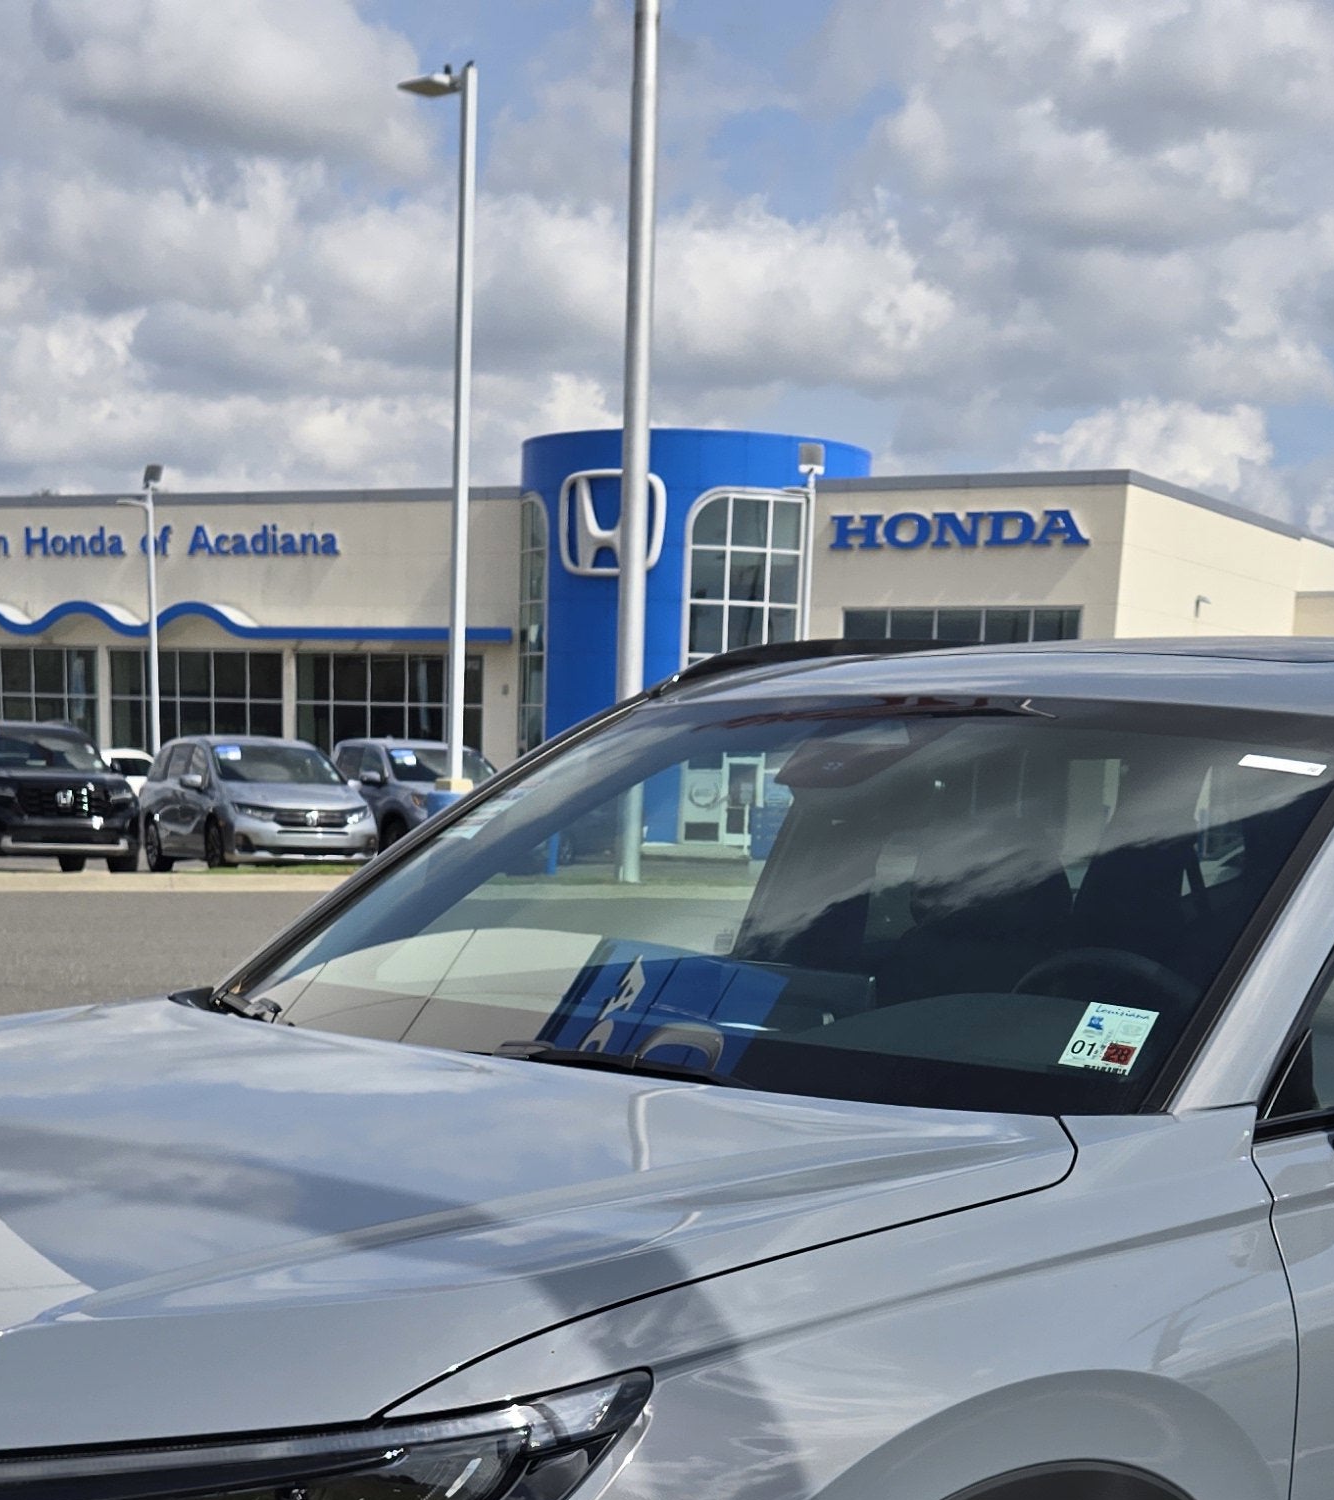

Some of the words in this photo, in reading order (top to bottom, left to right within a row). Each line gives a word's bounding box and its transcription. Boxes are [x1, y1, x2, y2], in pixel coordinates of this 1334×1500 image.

[24, 526, 125, 556] Honda
[140, 525, 172, 555] of
[187, 524, 340, 556] Acadiana
[830, 509, 1091, 549] HONDA
[1070, 1040, 1097, 1057] 01
